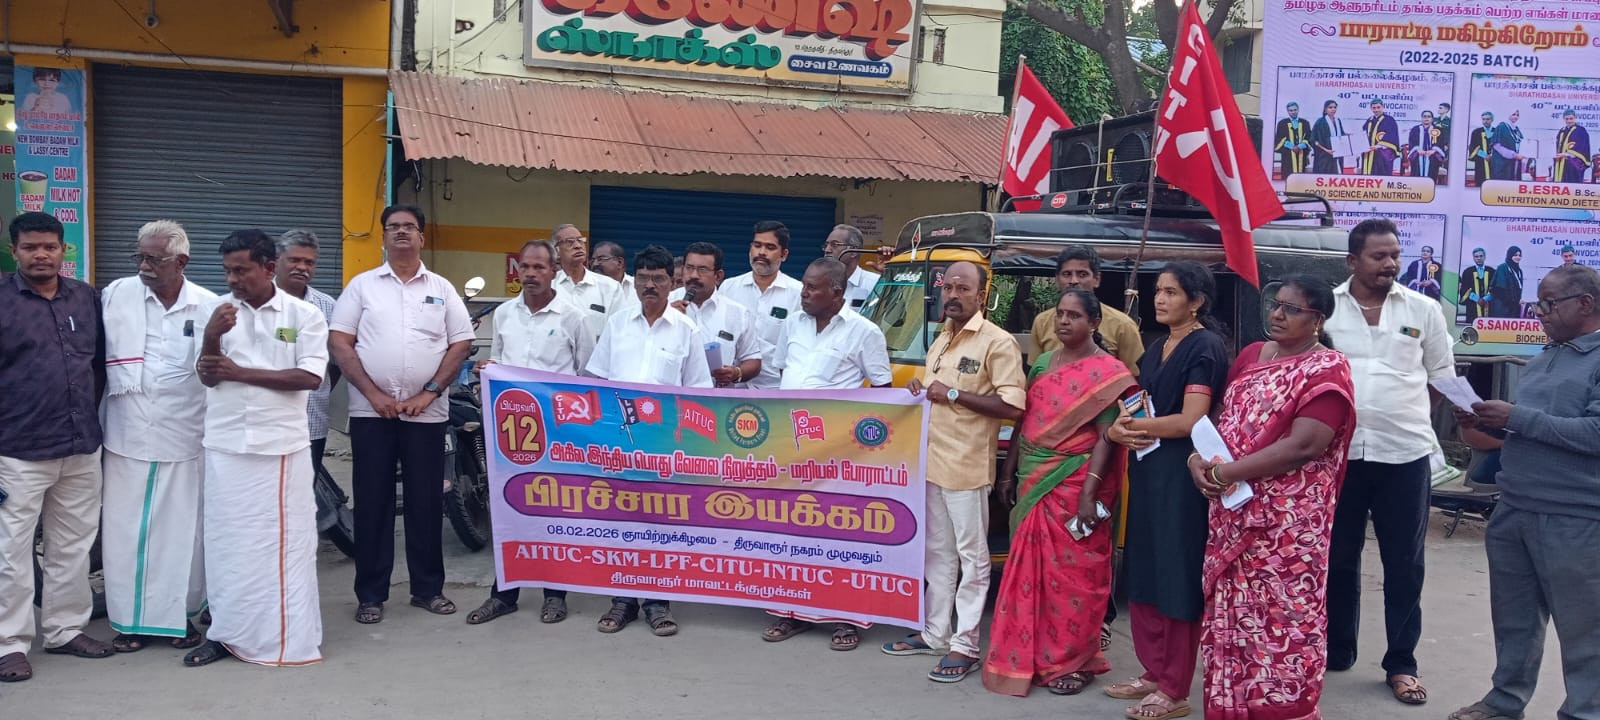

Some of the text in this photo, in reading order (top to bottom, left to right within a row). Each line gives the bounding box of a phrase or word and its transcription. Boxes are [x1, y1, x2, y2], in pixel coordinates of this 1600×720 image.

[1401, 2, 1433, 14] தங்க
[1436, 4, 1482, 15] பதக்கம்
[1485, 6, 1522, 19] பெற்ற
[1525, 7, 1568, 19] எங்கள்
[537, 17, 781, 69] ஸ்நாக்ஸ்
[1339, 20, 1589, 52] பாராட்டி மகிழ்கிறோம்
[791, 58, 890, 74] சைவ உணவகம்
[1400, 51, 1540, 70] (2022-2025 BATCH)
[55, 168, 76, 180] BADAM
[1316, 177, 1384, 189] S.KAVERY
[1518, 185, 1571, 195] B.ESRA
[50, 188, 80, 201] MILK HOT
[1328, 190, 1362, 199] SCIENCE
[1363, 191, 1380, 199] AND
[1381, 191, 1422, 200] NUTRITION
[1497, 196, 1548, 204] NUTRITION
[1477, 320, 1540, 331] S.SANOFAR
[500, 400, 537, 413] பிப்ரவரி
[555, 395, 566, 420] CITU
[624, 400, 636, 424] LPF
[684, 408, 714, 432] AITUC
[737, 419, 757, 431] SKM
[502, 414, 541, 451] 12
[800, 427, 821, 435] UTUC
[551, 443, 585, 463] அகில
[588, 446, 633, 472] இந்திய
[634, 452, 672, 477] பொது
[674, 451, 718, 475] வேலை
[722, 455, 777, 481] நிறுத்தம்
[791, 459, 838, 483] மறியல்
[841, 460, 908, 487] போராட்டம்
[524, 475, 895, 534] பிரச்சார இயக்கம்
[547, 525, 619, 538] 08.02.2026
[622, 530, 717, 546] ஞாயிற்றுக்கிழமை
[734, 537, 787, 555] திருவாரூர்
[790, 545, 824, 557] நகரம்
[826, 548, 882, 564] முழுவதும்
[610, 571, 681, 588] திருவாரூர்
